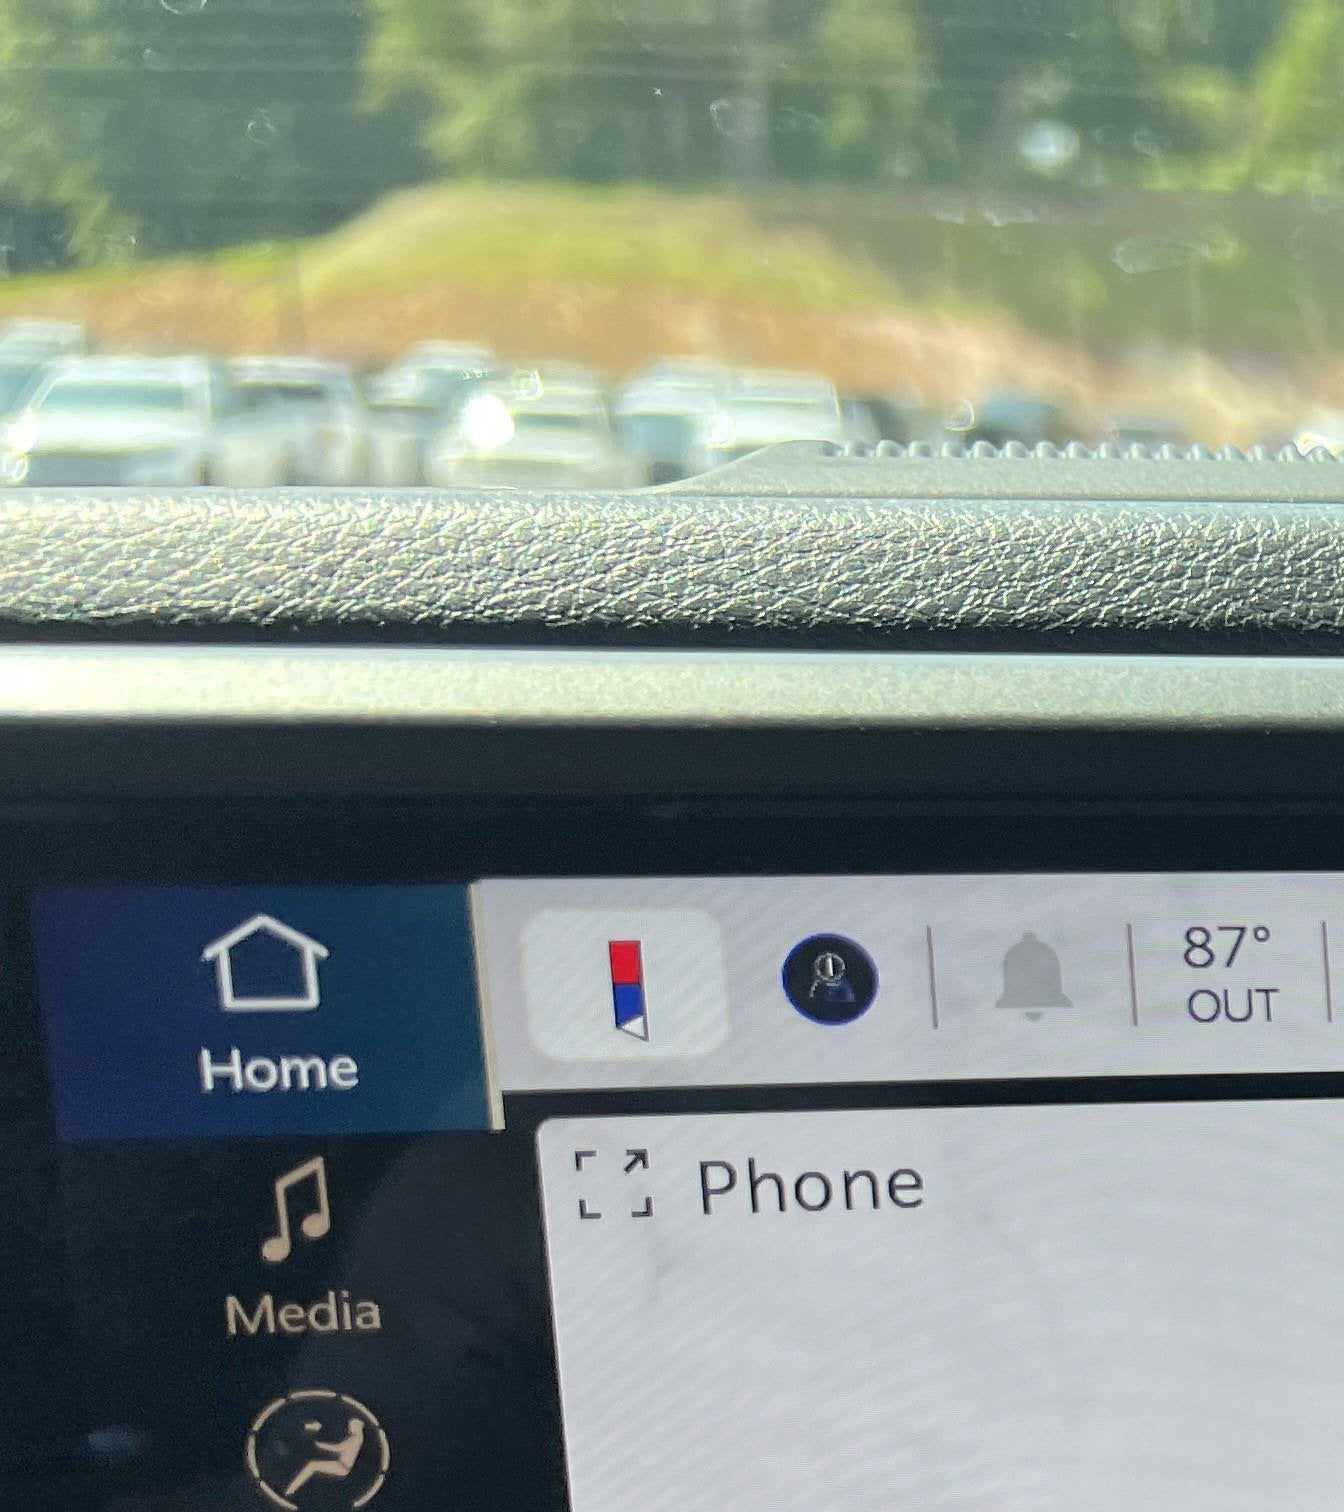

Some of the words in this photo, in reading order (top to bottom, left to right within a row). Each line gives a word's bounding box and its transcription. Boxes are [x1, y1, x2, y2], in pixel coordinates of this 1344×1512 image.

[1186, 987, 1281, 1025] OUT
[199, 1046, 360, 1093] Home
[698, 1156, 924, 1216] Phone
[225, 1289, 383, 1336] Media
